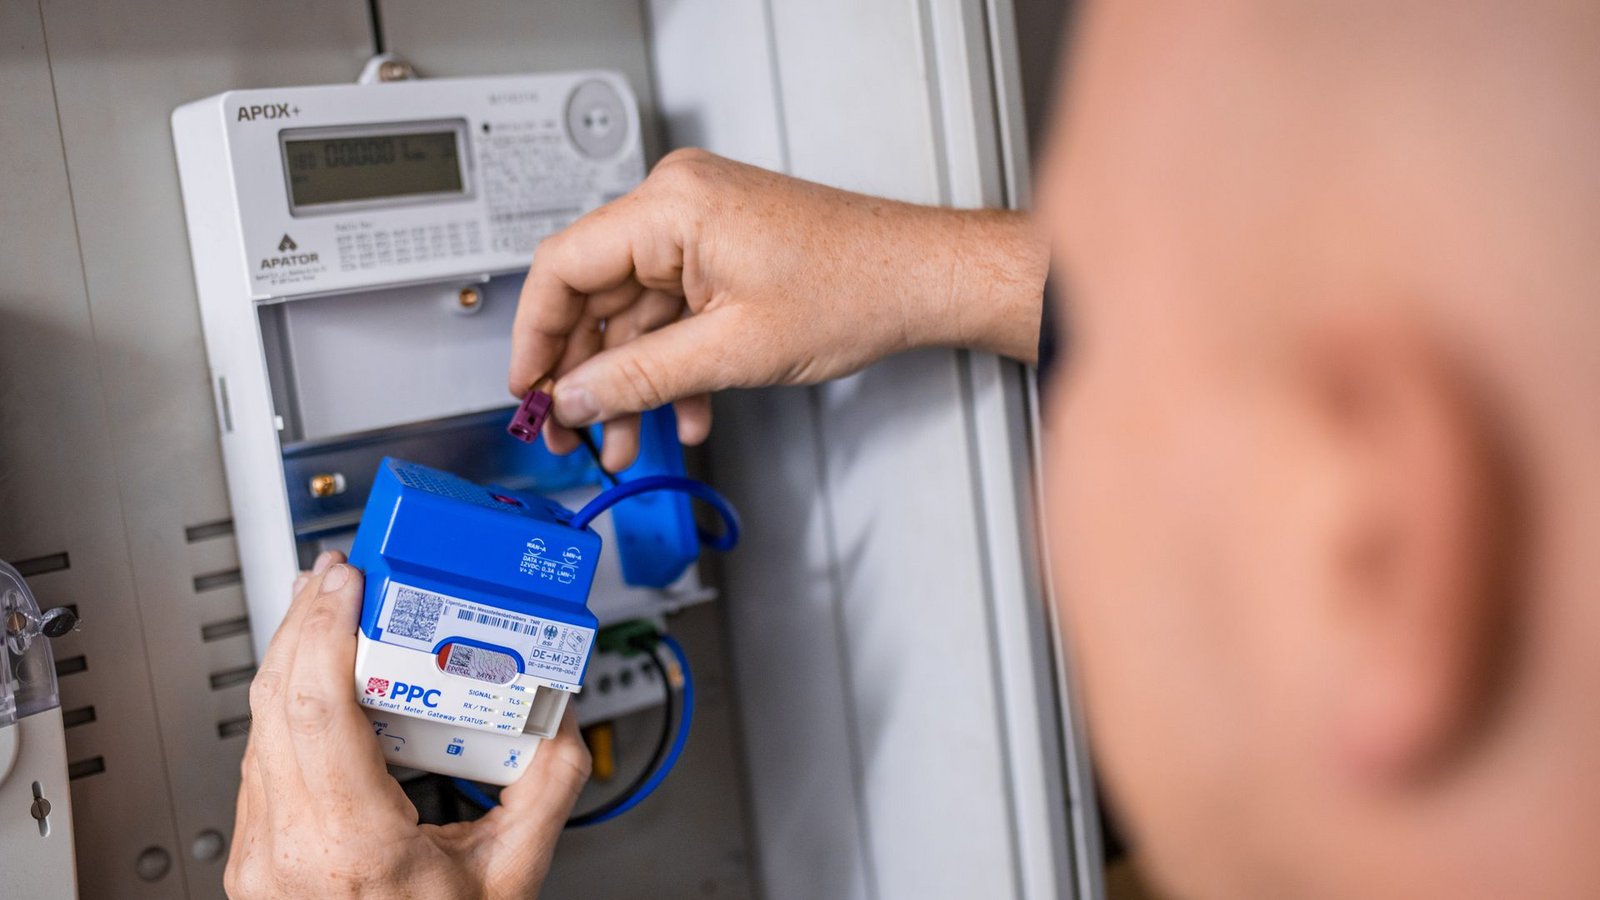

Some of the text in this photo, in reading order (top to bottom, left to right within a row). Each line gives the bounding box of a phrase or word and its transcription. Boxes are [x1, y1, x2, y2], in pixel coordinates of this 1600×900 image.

[260, 253, 319, 270] APATOR
[523, 555, 537, 563] DATA
[563, 551, 581, 560] LMN-A
[445, 599, 468, 609] Eigentum
[541, 640, 553, 648] BSI
[532, 649, 576, 667] DE-M 23
[510, 684, 526, 692] PWR
[550, 682, 565, 690] HAN
[389, 681, 442, 709] PPC
[468, 689, 493, 700] SIGNAL
[508, 698, 521, 706] TLS
[361, 697, 457, 723] LTE Smart Meter Gateway
[502, 711, 517, 719] LMC
[372, 720, 389, 729] PWR
[459, 715, 484, 726] STATUS
[393, 745, 401, 753] N
